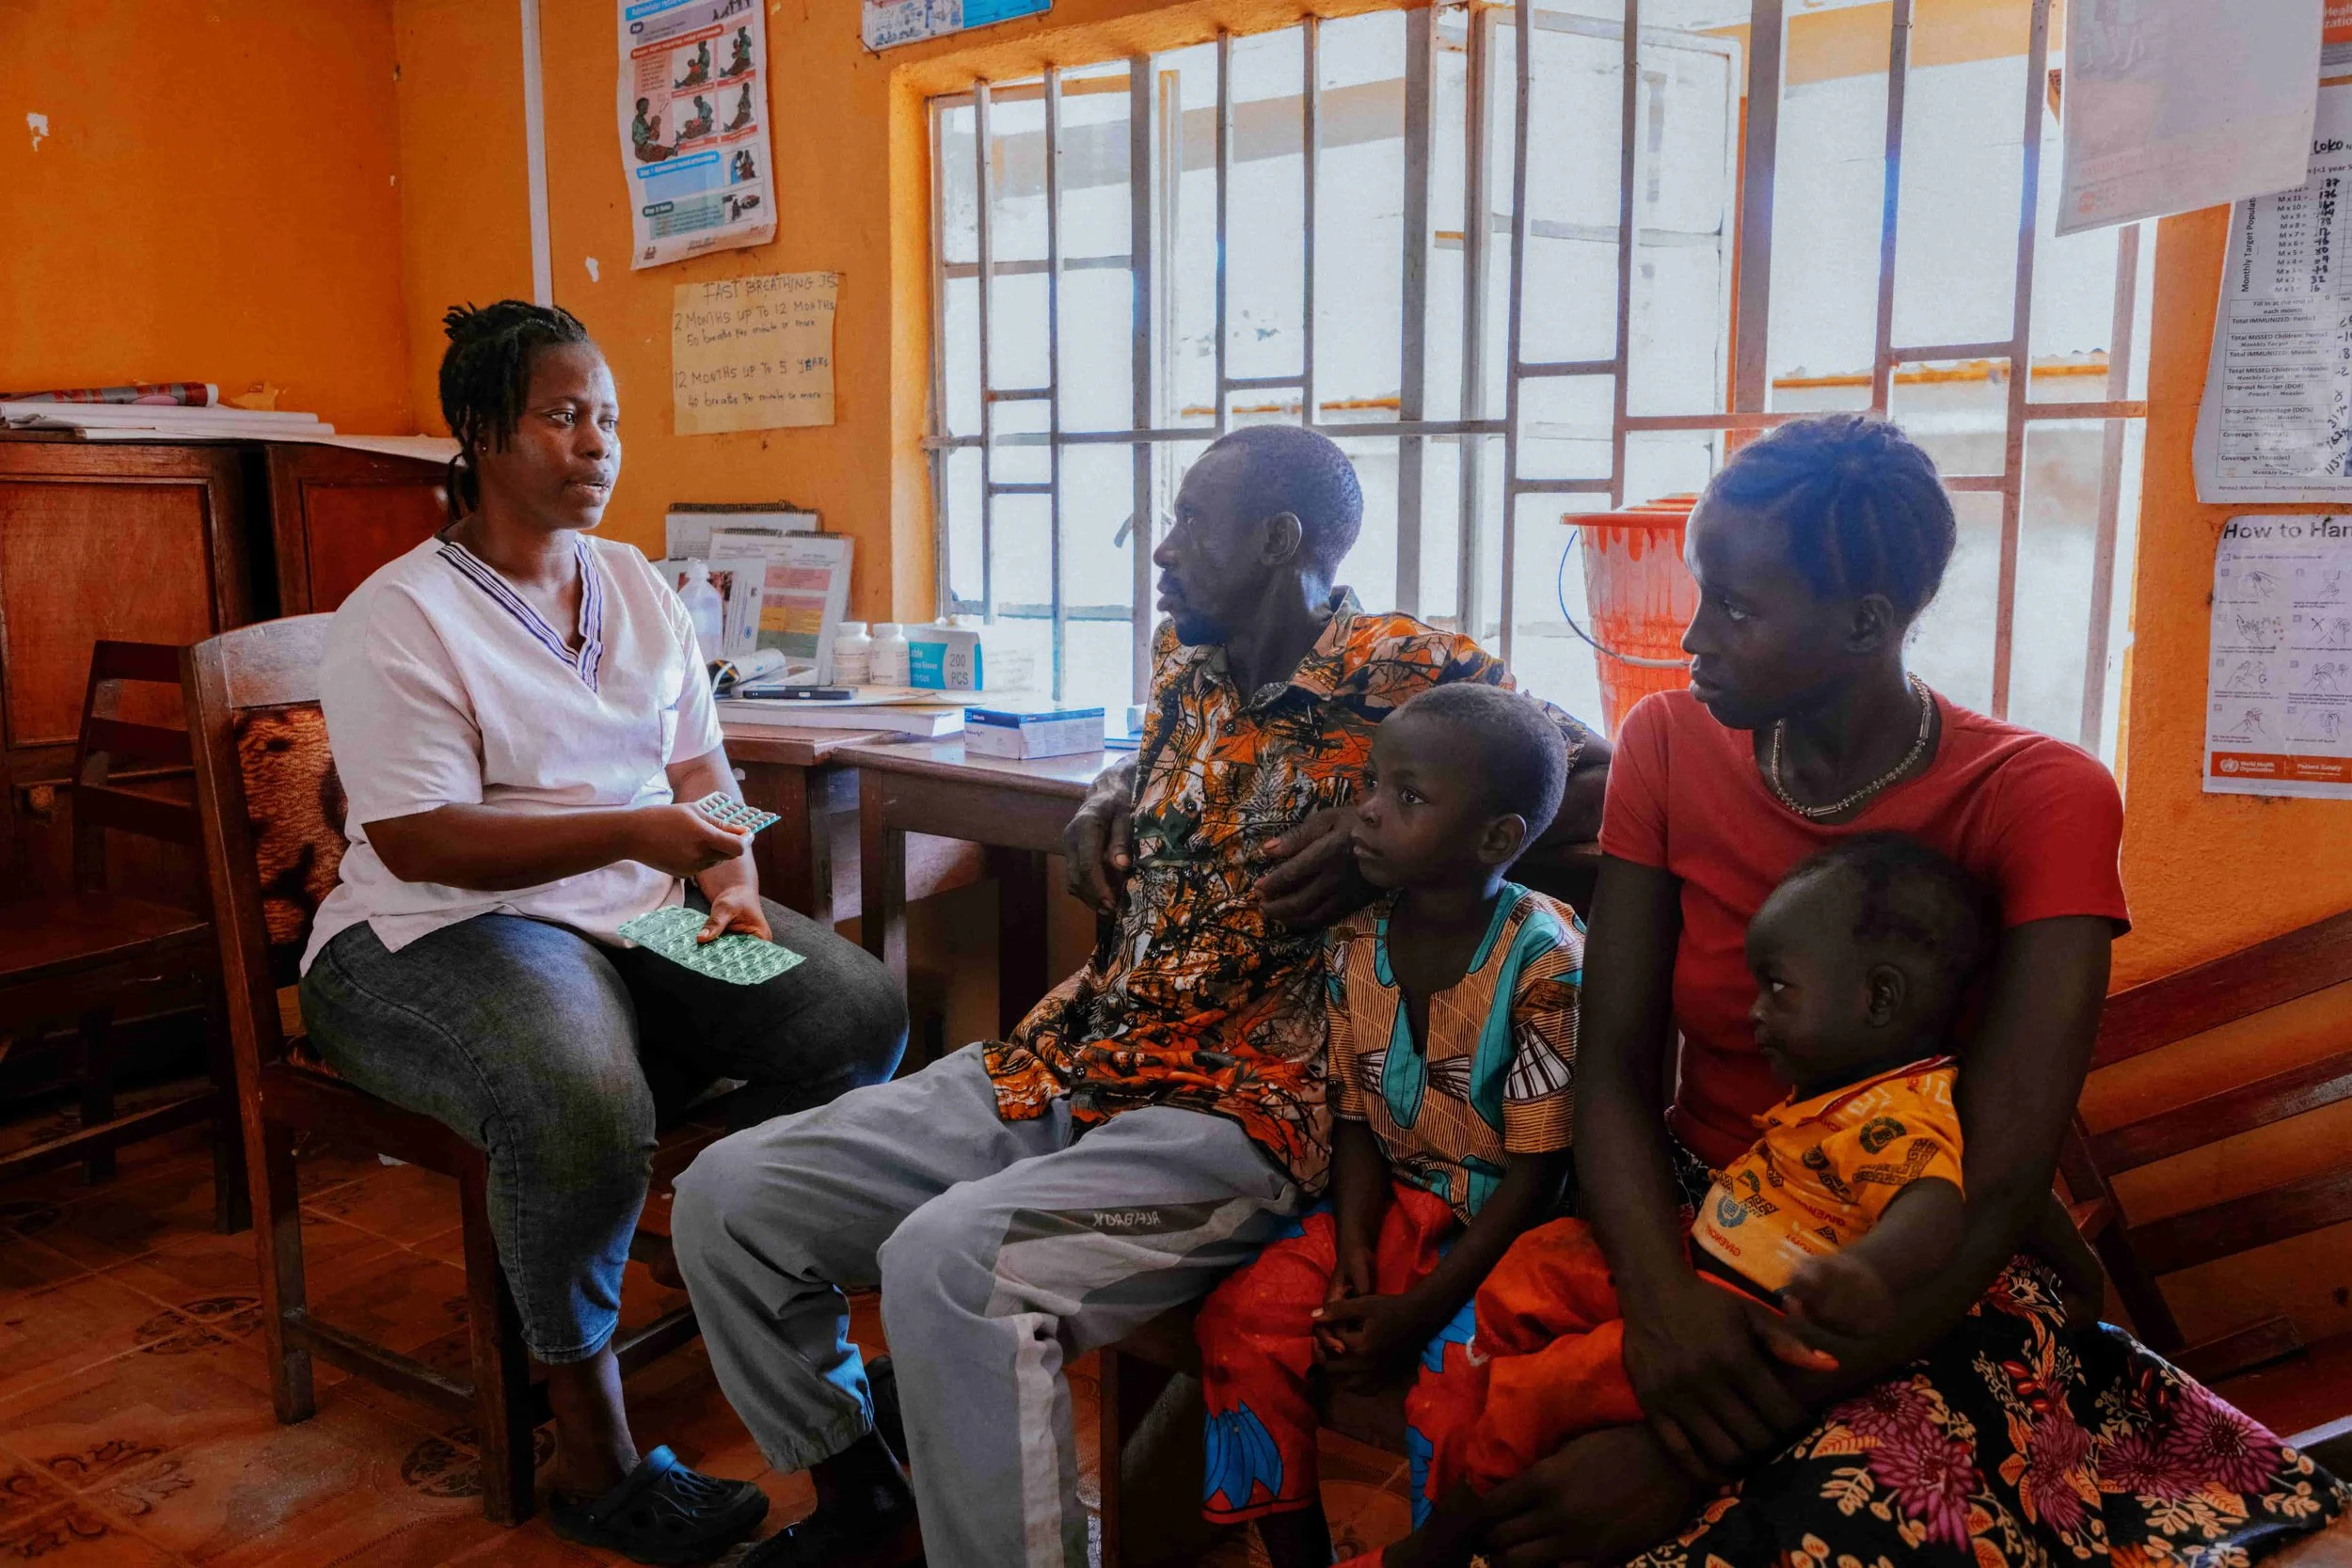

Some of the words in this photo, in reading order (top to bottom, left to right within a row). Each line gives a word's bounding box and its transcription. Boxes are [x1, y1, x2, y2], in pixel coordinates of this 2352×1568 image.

[2244, 232, 2254, 257] Target
[2241, 259, 2253, 293] Monthly
[703, 279, 741, 306] FAST
[675, 313, 683, 331] 2
[686, 311, 731, 329] MONTHS
[774, 303, 787, 315] 12
[793, 301, 835, 311] MONTHS
[675, 371, 687, 389] 12
[691, 366, 738, 384] MONTHS
[779, 360, 787, 374] 5
[2223, 523, 2272, 540] How
[2280, 523, 2302, 538] to
[949, 653, 966, 667] 200
[951, 672, 969, 686] PCS
